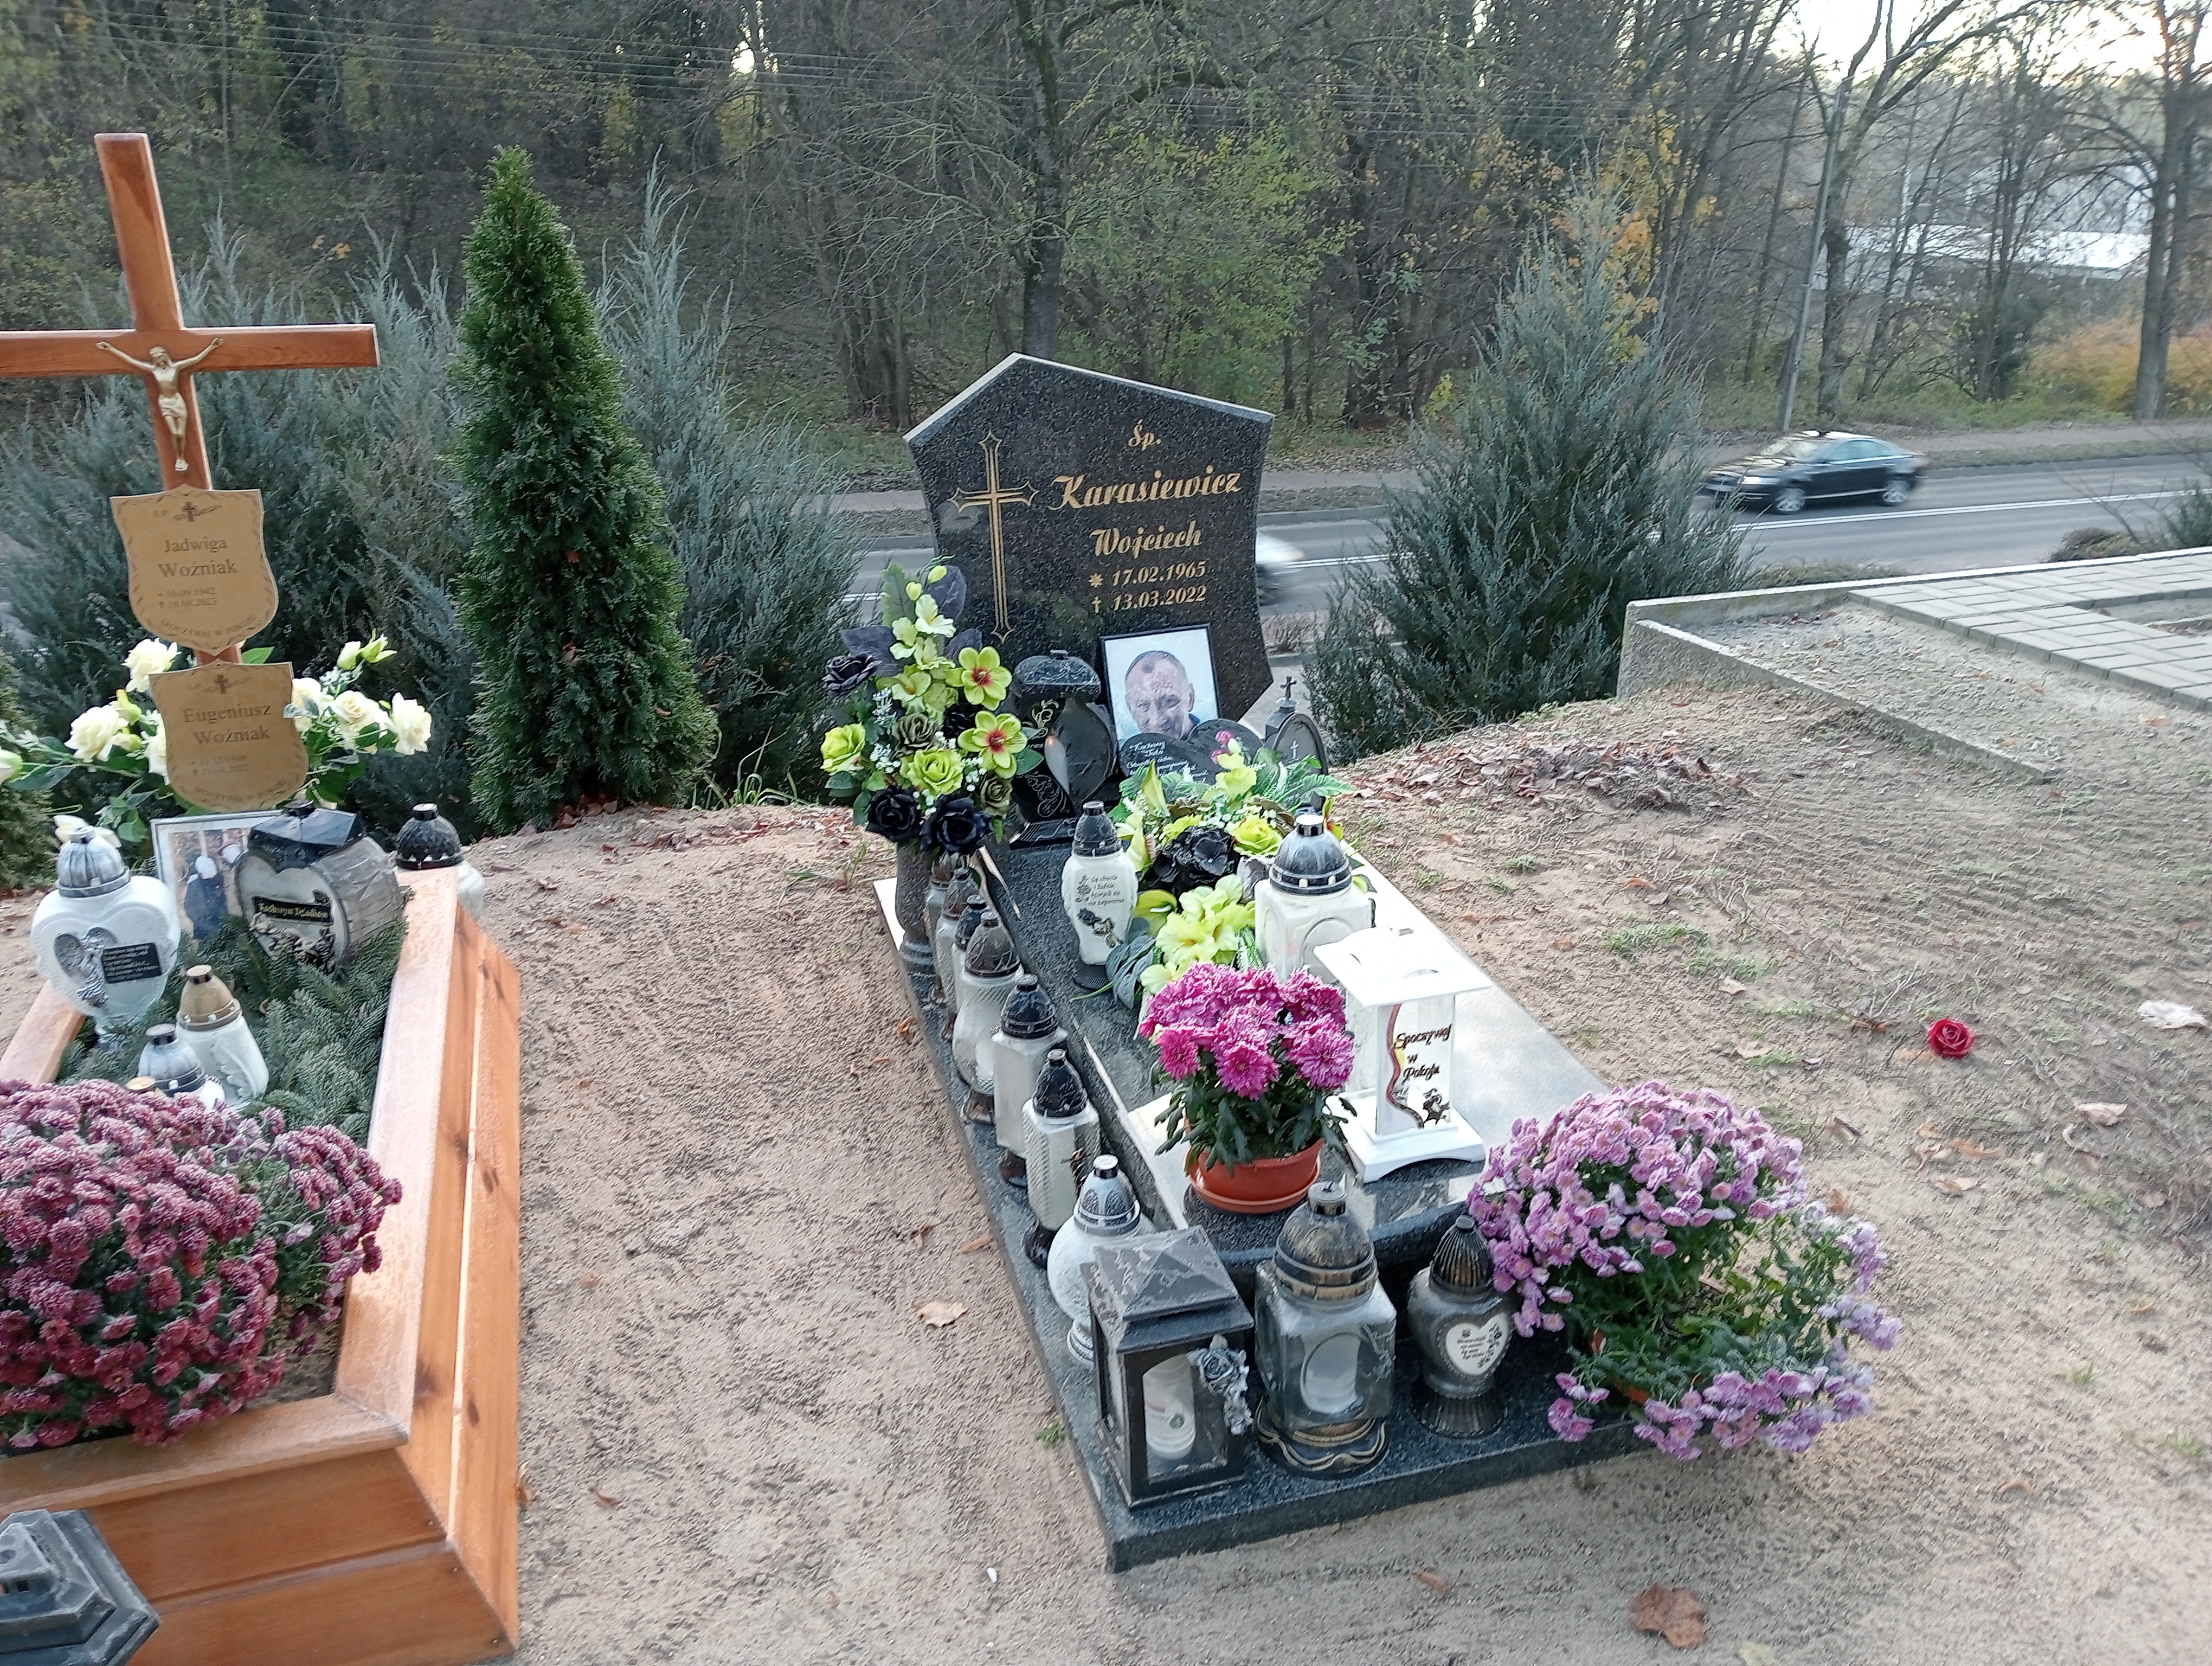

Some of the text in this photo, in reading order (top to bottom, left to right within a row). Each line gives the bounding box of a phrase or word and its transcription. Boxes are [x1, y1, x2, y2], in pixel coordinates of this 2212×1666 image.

[1128, 419, 1161, 451] Śp.
[1047, 465, 1243, 510] Karasiewicz
[164, 536, 227, 553] Jadwiga
[1089, 520, 1203, 559] Wojciech
[157, 559, 237, 578] Woźniak
[1113, 561, 1207, 586] 17.02.1965
[1114, 585, 1207, 611] 13.03.2022
[183, 703, 271, 725] Eugeniusz
[194, 725, 271, 745] Woźniak
[1393, 1023, 1452, 1050] Spoczywaj
[1401, 1063, 1440, 1085] Pokoju
